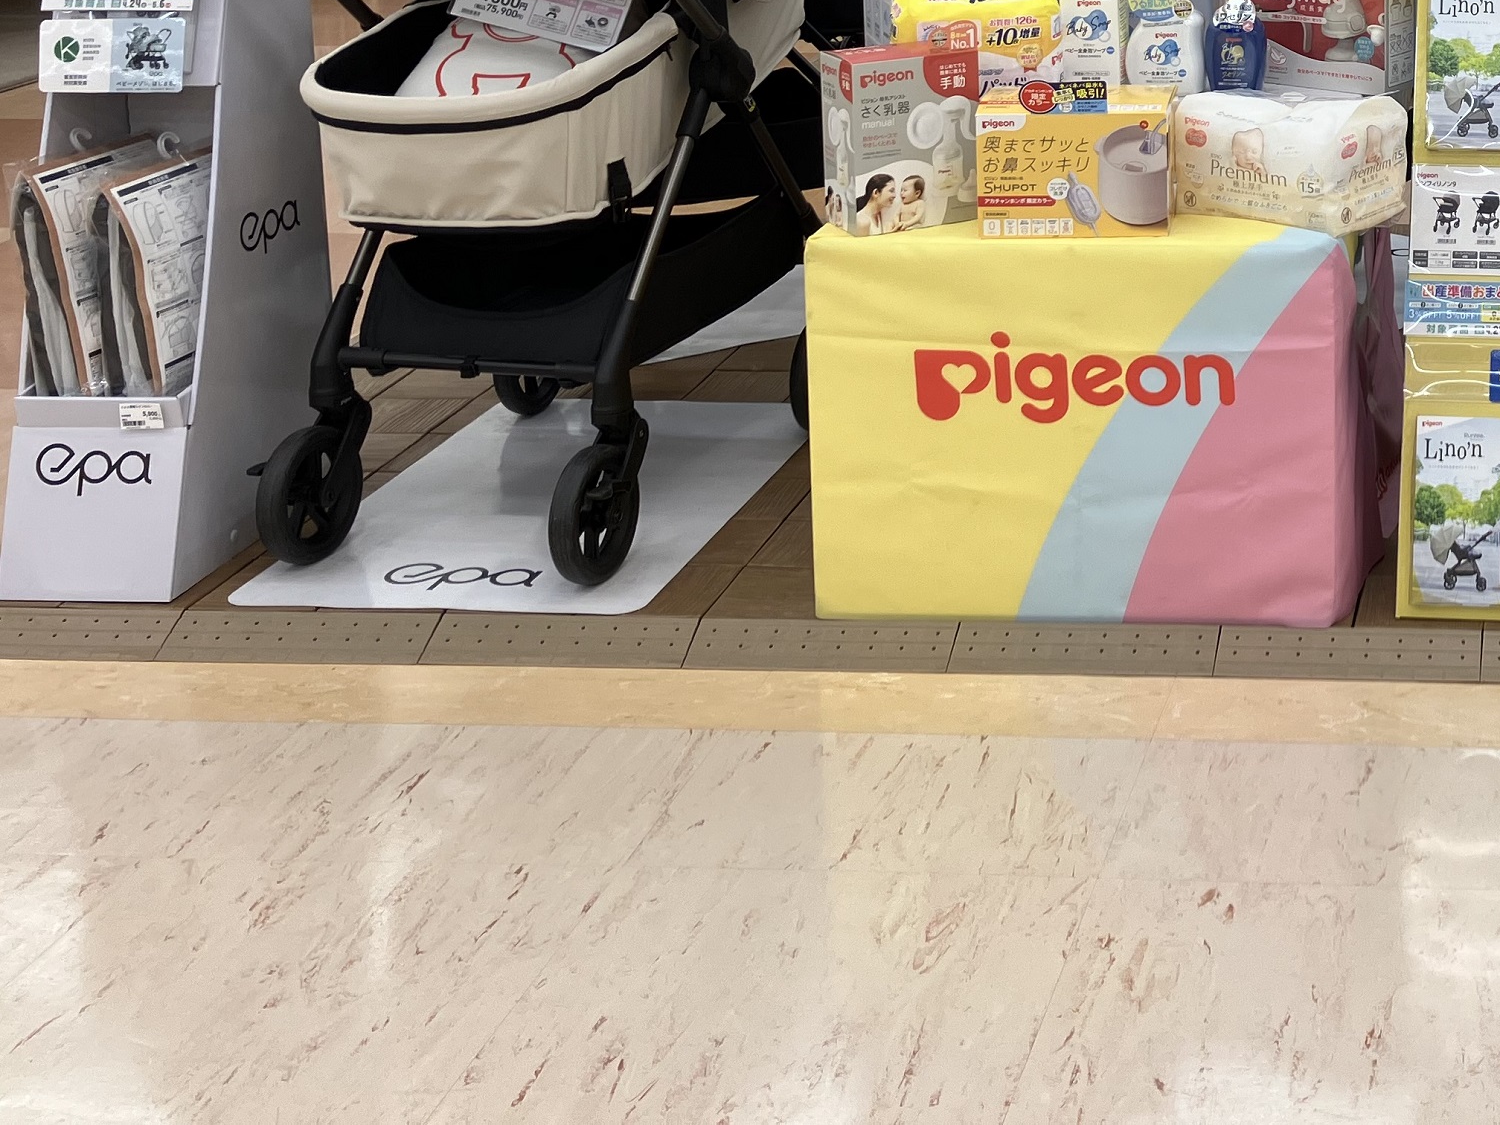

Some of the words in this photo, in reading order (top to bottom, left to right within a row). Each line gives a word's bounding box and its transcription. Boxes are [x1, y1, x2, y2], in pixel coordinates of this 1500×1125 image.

[860, 70, 914, 89] pigeon
[940, 75, 965, 89] 手動
[861, 101, 911, 117] さく乳器
[861, 118, 895, 129] manual
[982, 120, 1015, 129] pigeon
[1184, 116, 1210, 128] pigeon
[983, 136, 1089, 154] 奥までサッと
[983, 157, 1090, 174] お鼻スッキリ
[1210, 159, 1287, 187] Premium
[1349, 158, 1392, 183] Premium
[984, 181, 1037, 194] SHUPOT
[239, 199, 300, 255] epa
[913, 330, 1236, 424] pigeon
[35, 442, 152, 497] epa
[383, 561, 543, 591] epa
